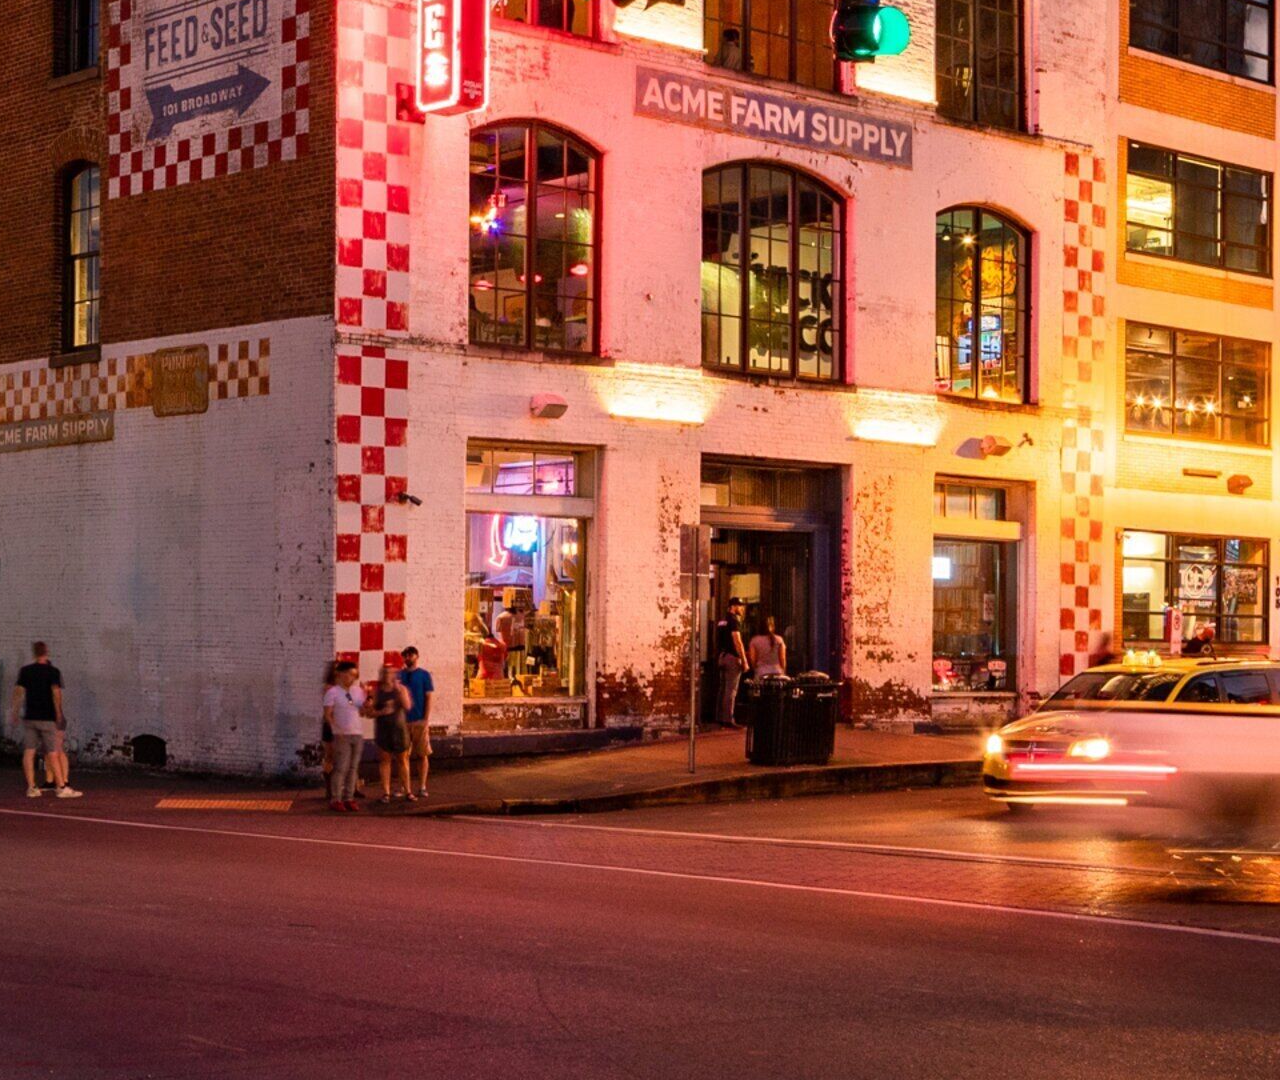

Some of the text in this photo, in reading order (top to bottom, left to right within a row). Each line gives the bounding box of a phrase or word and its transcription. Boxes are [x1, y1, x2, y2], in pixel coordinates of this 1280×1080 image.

[145, 15, 198, 71] FEED
[162, 85, 244, 117] 101 BROADWAY
[642, 77, 907, 158] ACME FARM SUPPLY
[25, 423, 58, 443] FARM
[61, 417, 110, 439] SUPPLY
